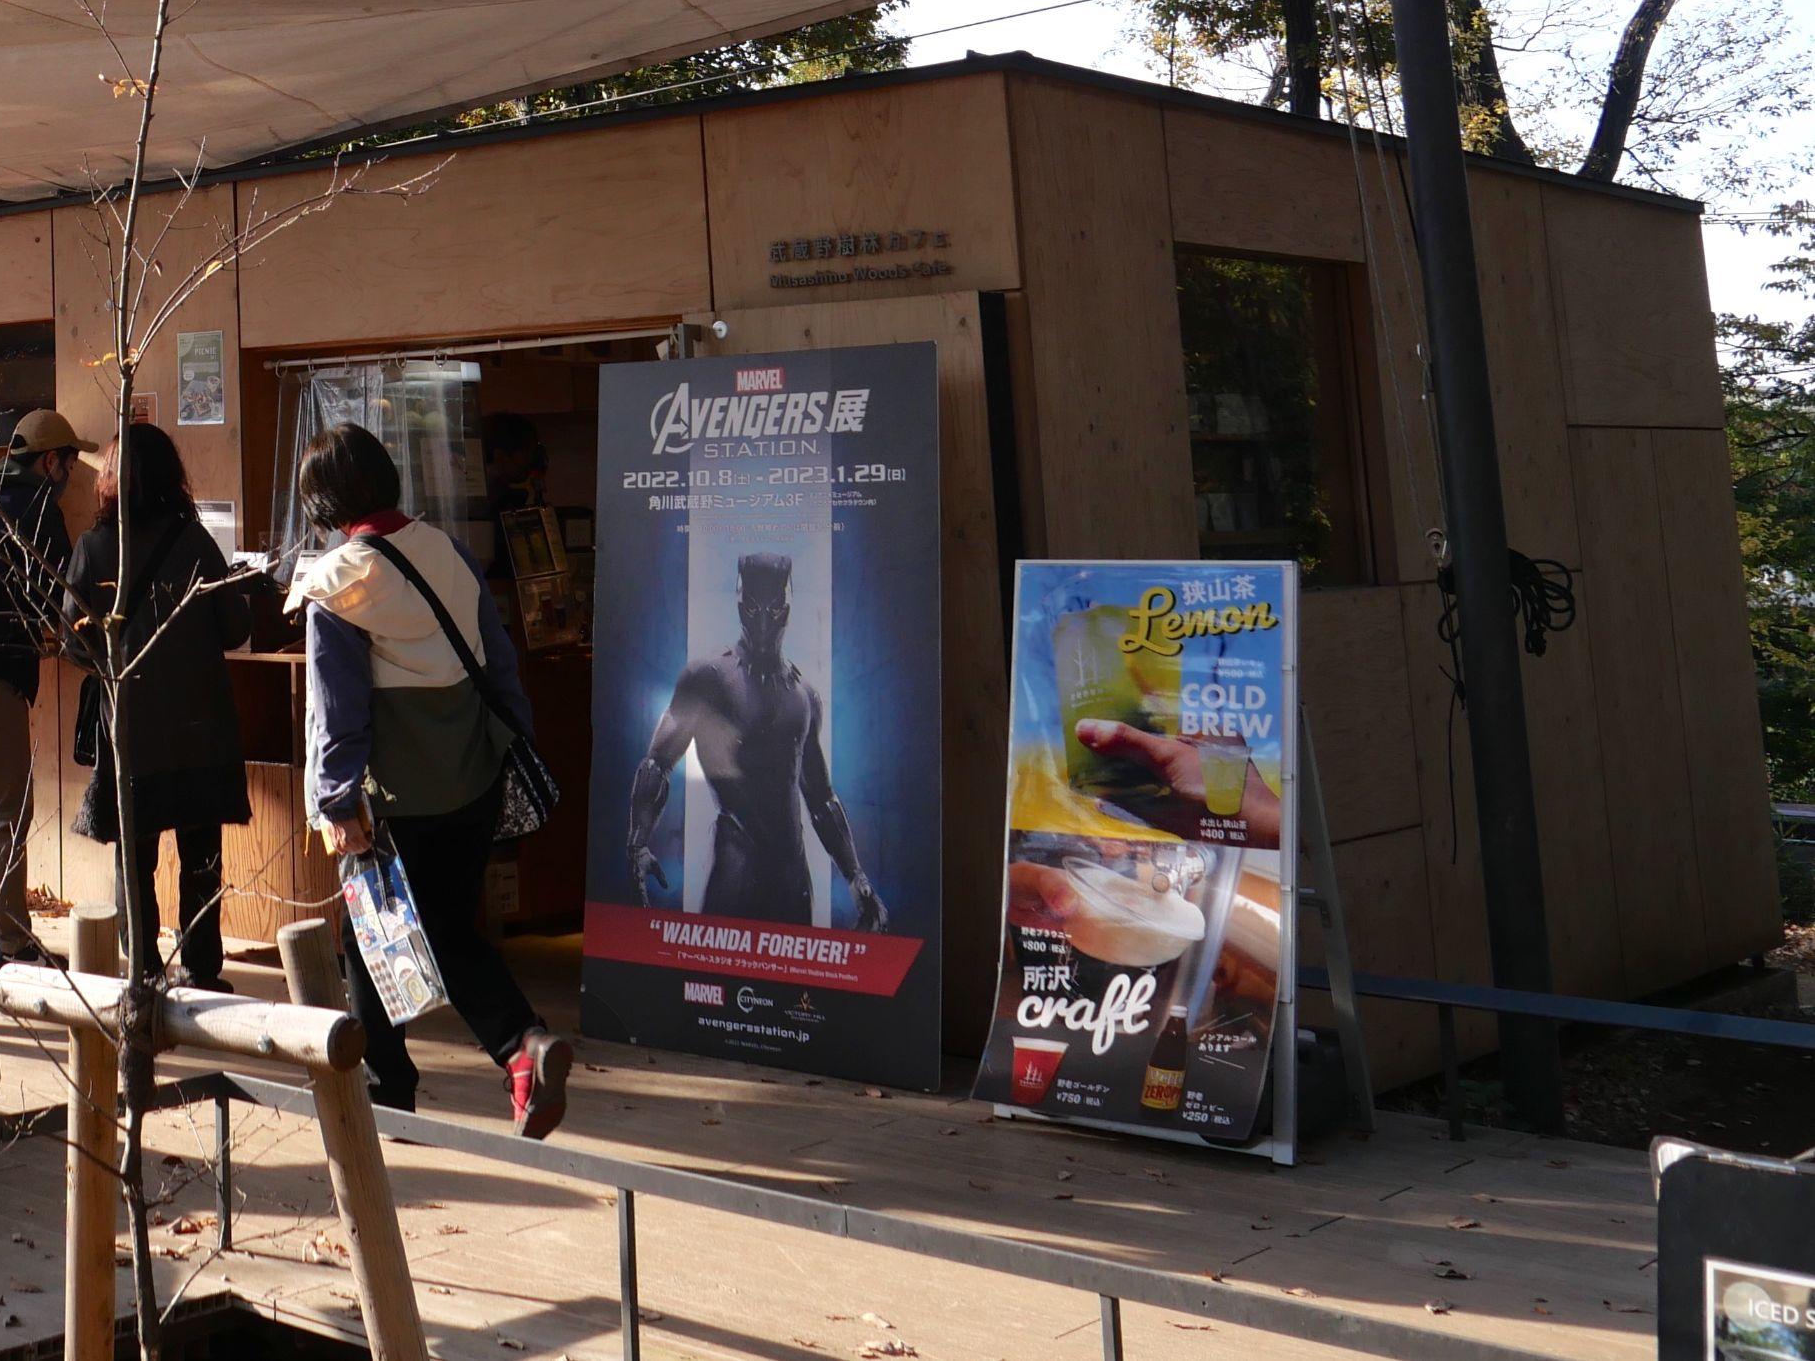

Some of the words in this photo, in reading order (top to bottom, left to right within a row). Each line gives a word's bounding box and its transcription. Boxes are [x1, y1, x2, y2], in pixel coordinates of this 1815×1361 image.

[737, 369, 783, 391] MARVEL
[1182, 574, 1256, 605] 狭山茶
[1117, 587, 1279, 656] Lemon
[1182, 683, 1266, 710] COLD
[1181, 711, 1273, 739] BREW
[1022, 965, 1072, 991] 所沢
[685, 981, 724, 1006] MARVEL
[1017, 973, 1158, 1056] craft
[698, 1016, 810, 1043] avengersstation.jp
[1199, 1033, 1257, 1043] ノンアルコール
[1198, 1042, 1231, 1053] あります
[1747, 1298, 1800, 1325] ICED
